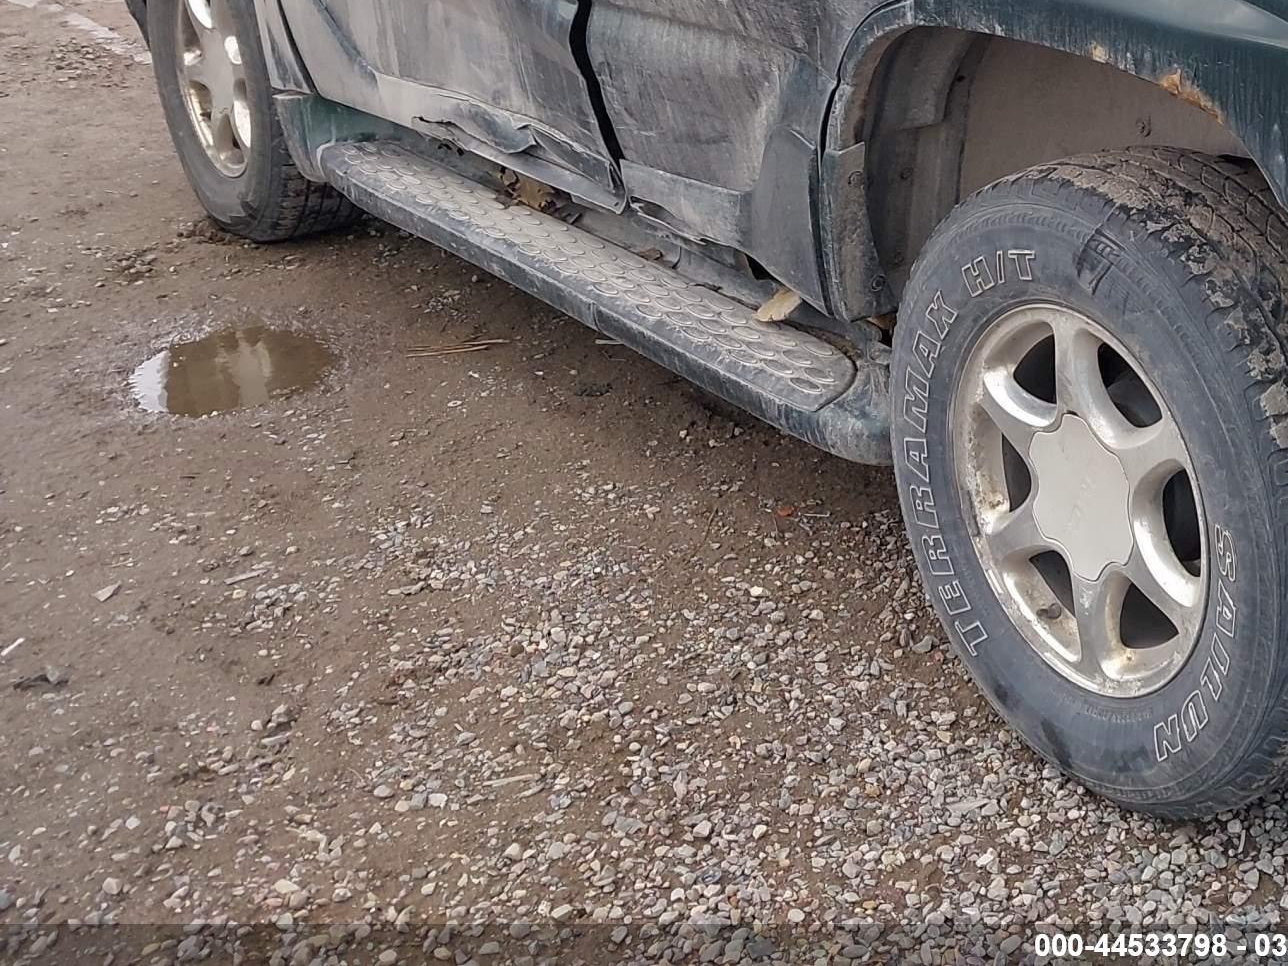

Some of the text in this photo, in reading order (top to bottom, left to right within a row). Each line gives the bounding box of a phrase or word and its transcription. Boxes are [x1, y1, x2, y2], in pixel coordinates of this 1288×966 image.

[902, 248, 1036, 658] TERRAMAX H/T
[1153, 523, 1237, 763] SAILUN
